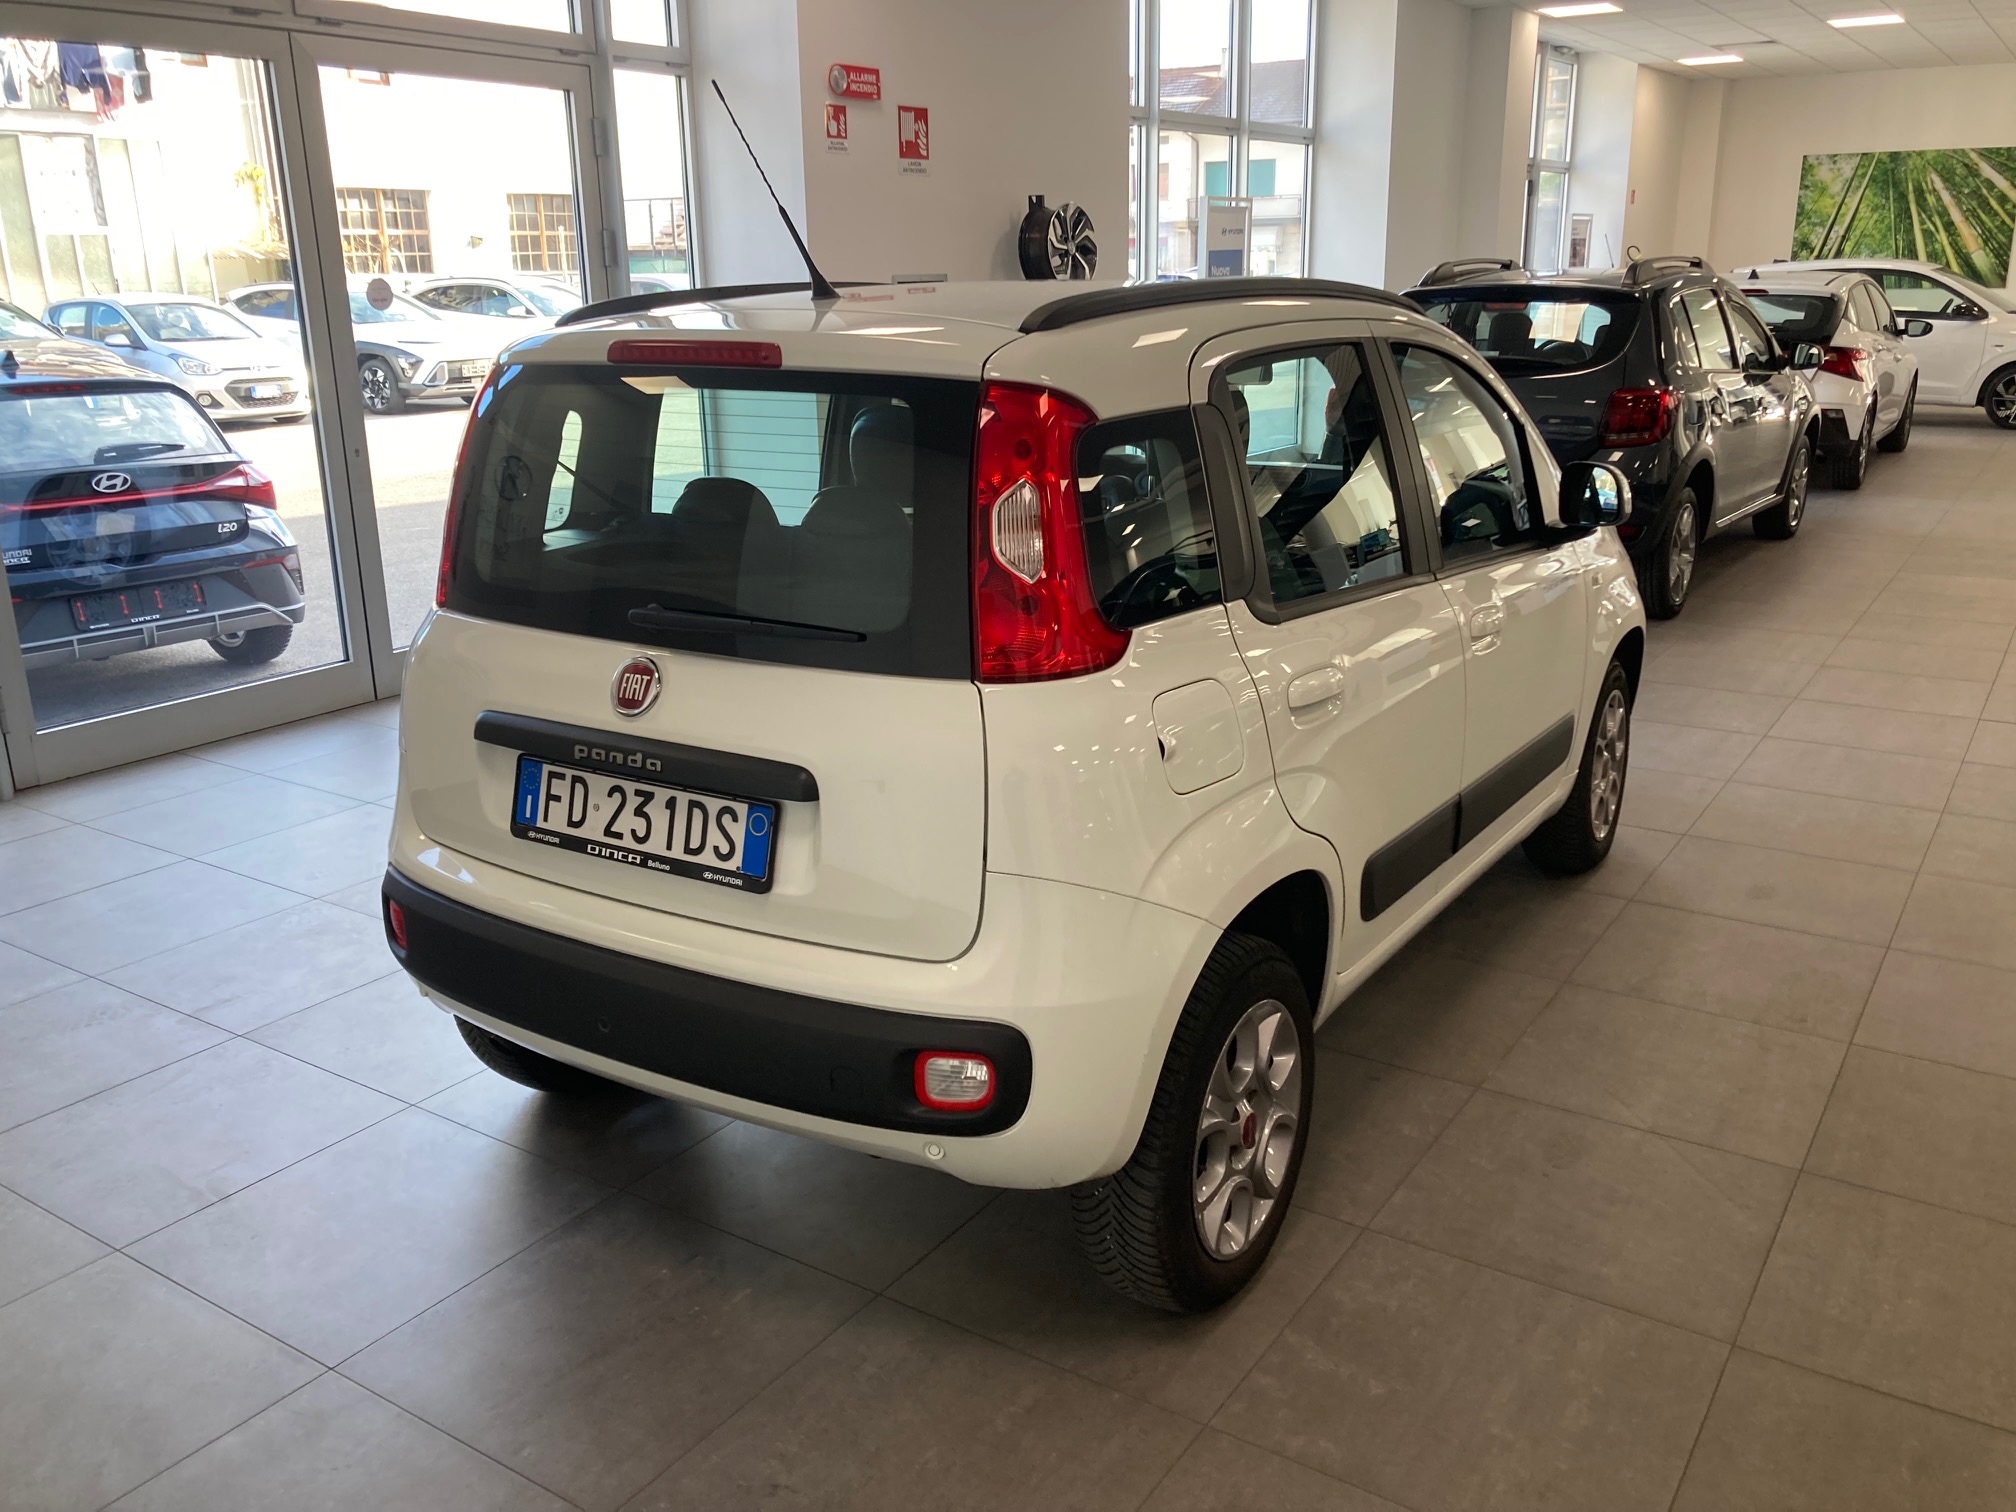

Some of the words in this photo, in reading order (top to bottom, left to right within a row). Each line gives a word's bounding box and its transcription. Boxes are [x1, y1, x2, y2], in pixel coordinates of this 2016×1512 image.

[850, 72, 877, 84] ALLARME
[850, 82, 878, 94] INCENDIO
[2, 549, 32, 560] UNDAI
[619, 673, 651, 701] FIAT
[574, 744, 662, 772] panda
[536, 833, 560, 844] HYUNDAI
[647, 860, 671, 871] Belluno
[713, 874, 743, 886] HYUNDAI
